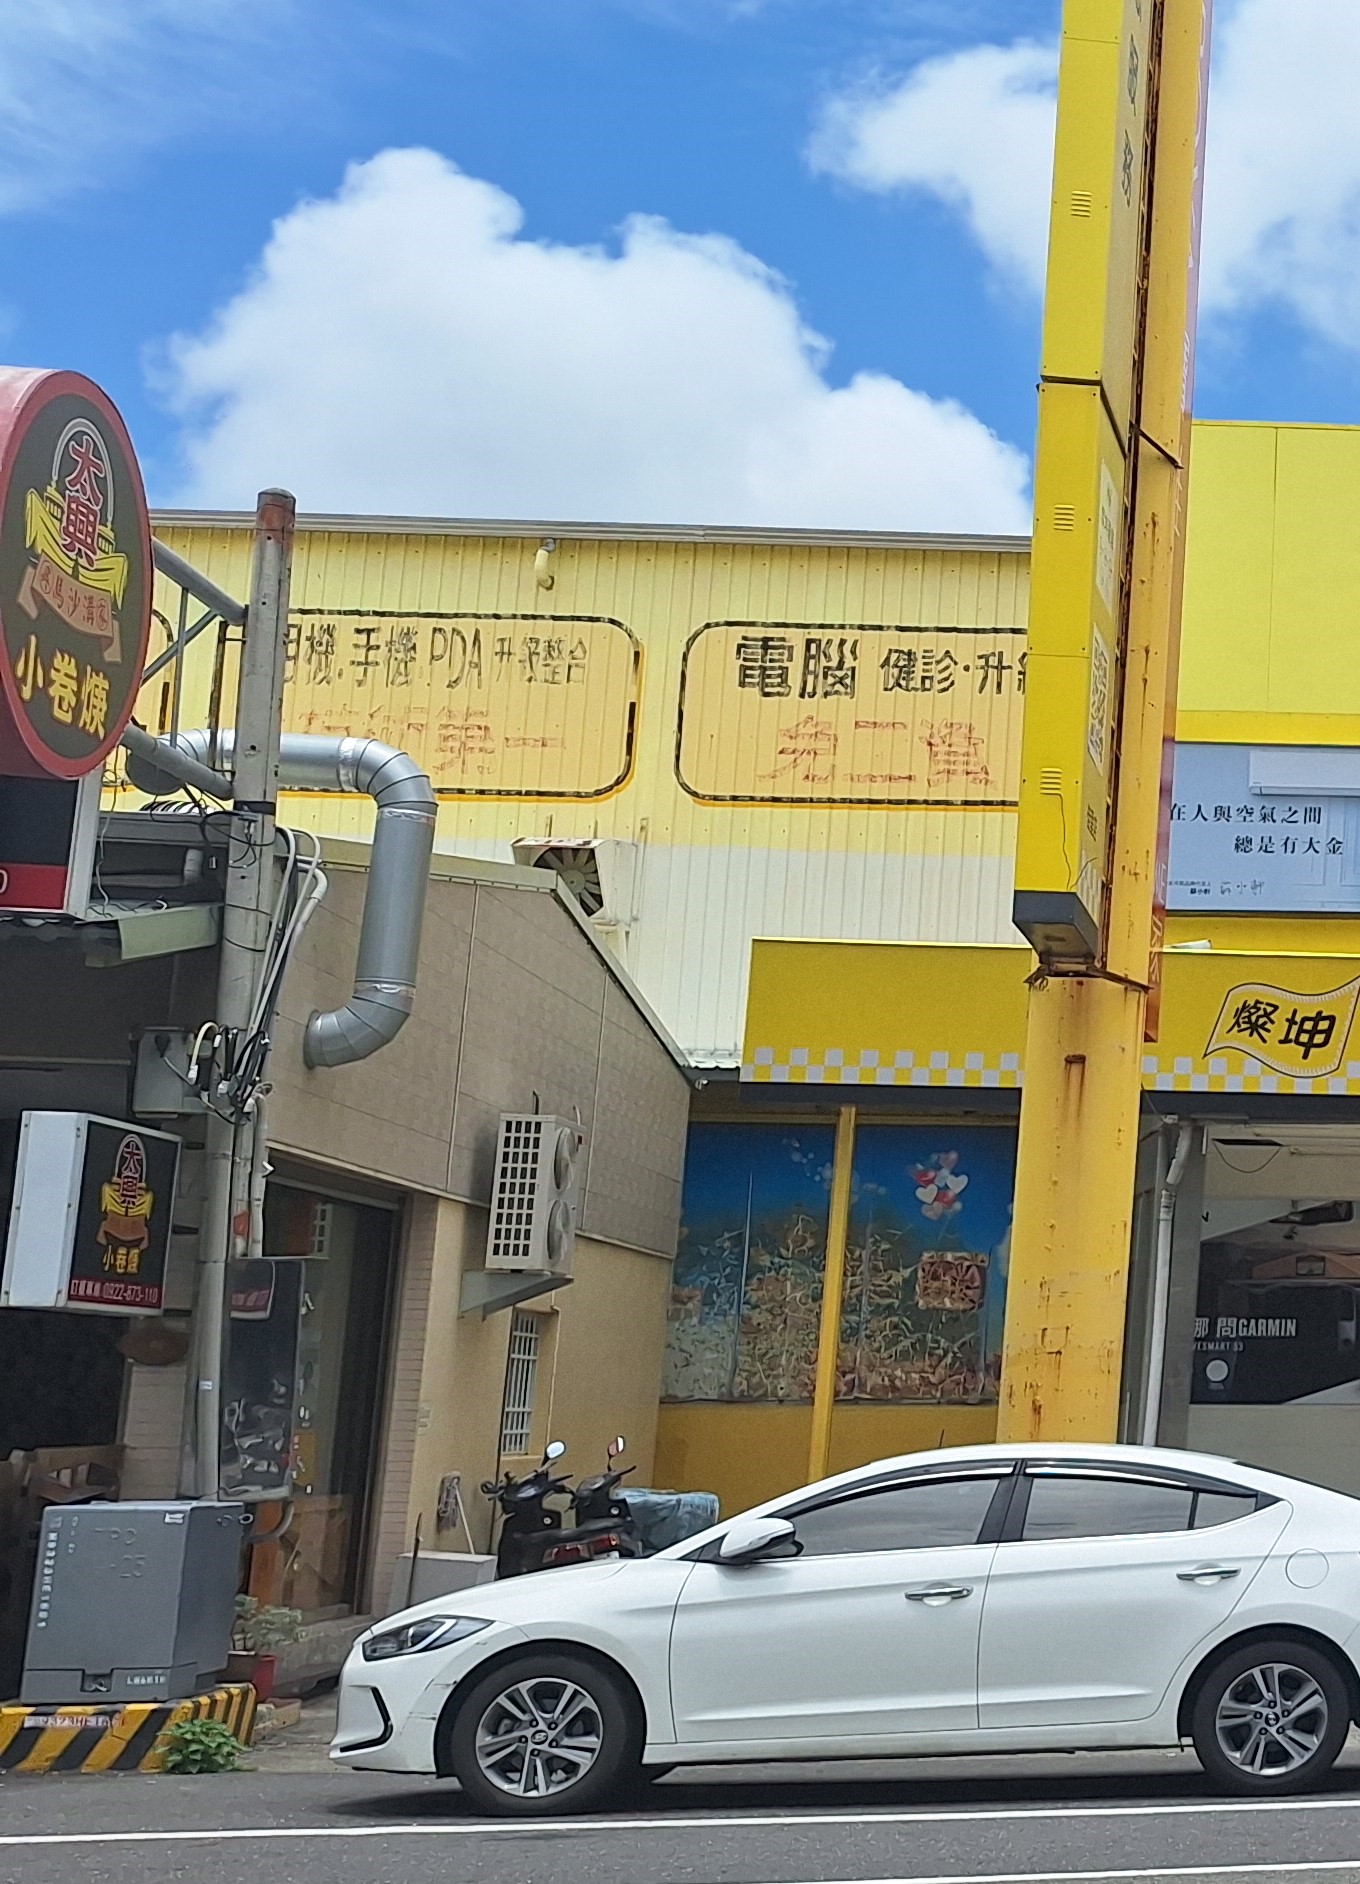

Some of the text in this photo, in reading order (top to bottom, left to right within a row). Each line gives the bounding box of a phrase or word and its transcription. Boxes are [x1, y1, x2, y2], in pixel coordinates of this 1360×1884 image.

[61, 435, 104, 570] 太興
[735, 636, 859, 699] 電腦
[1234, 834, 1345, 857] 總是有大金
[1226, 999, 1337, 1060] 燦坤
